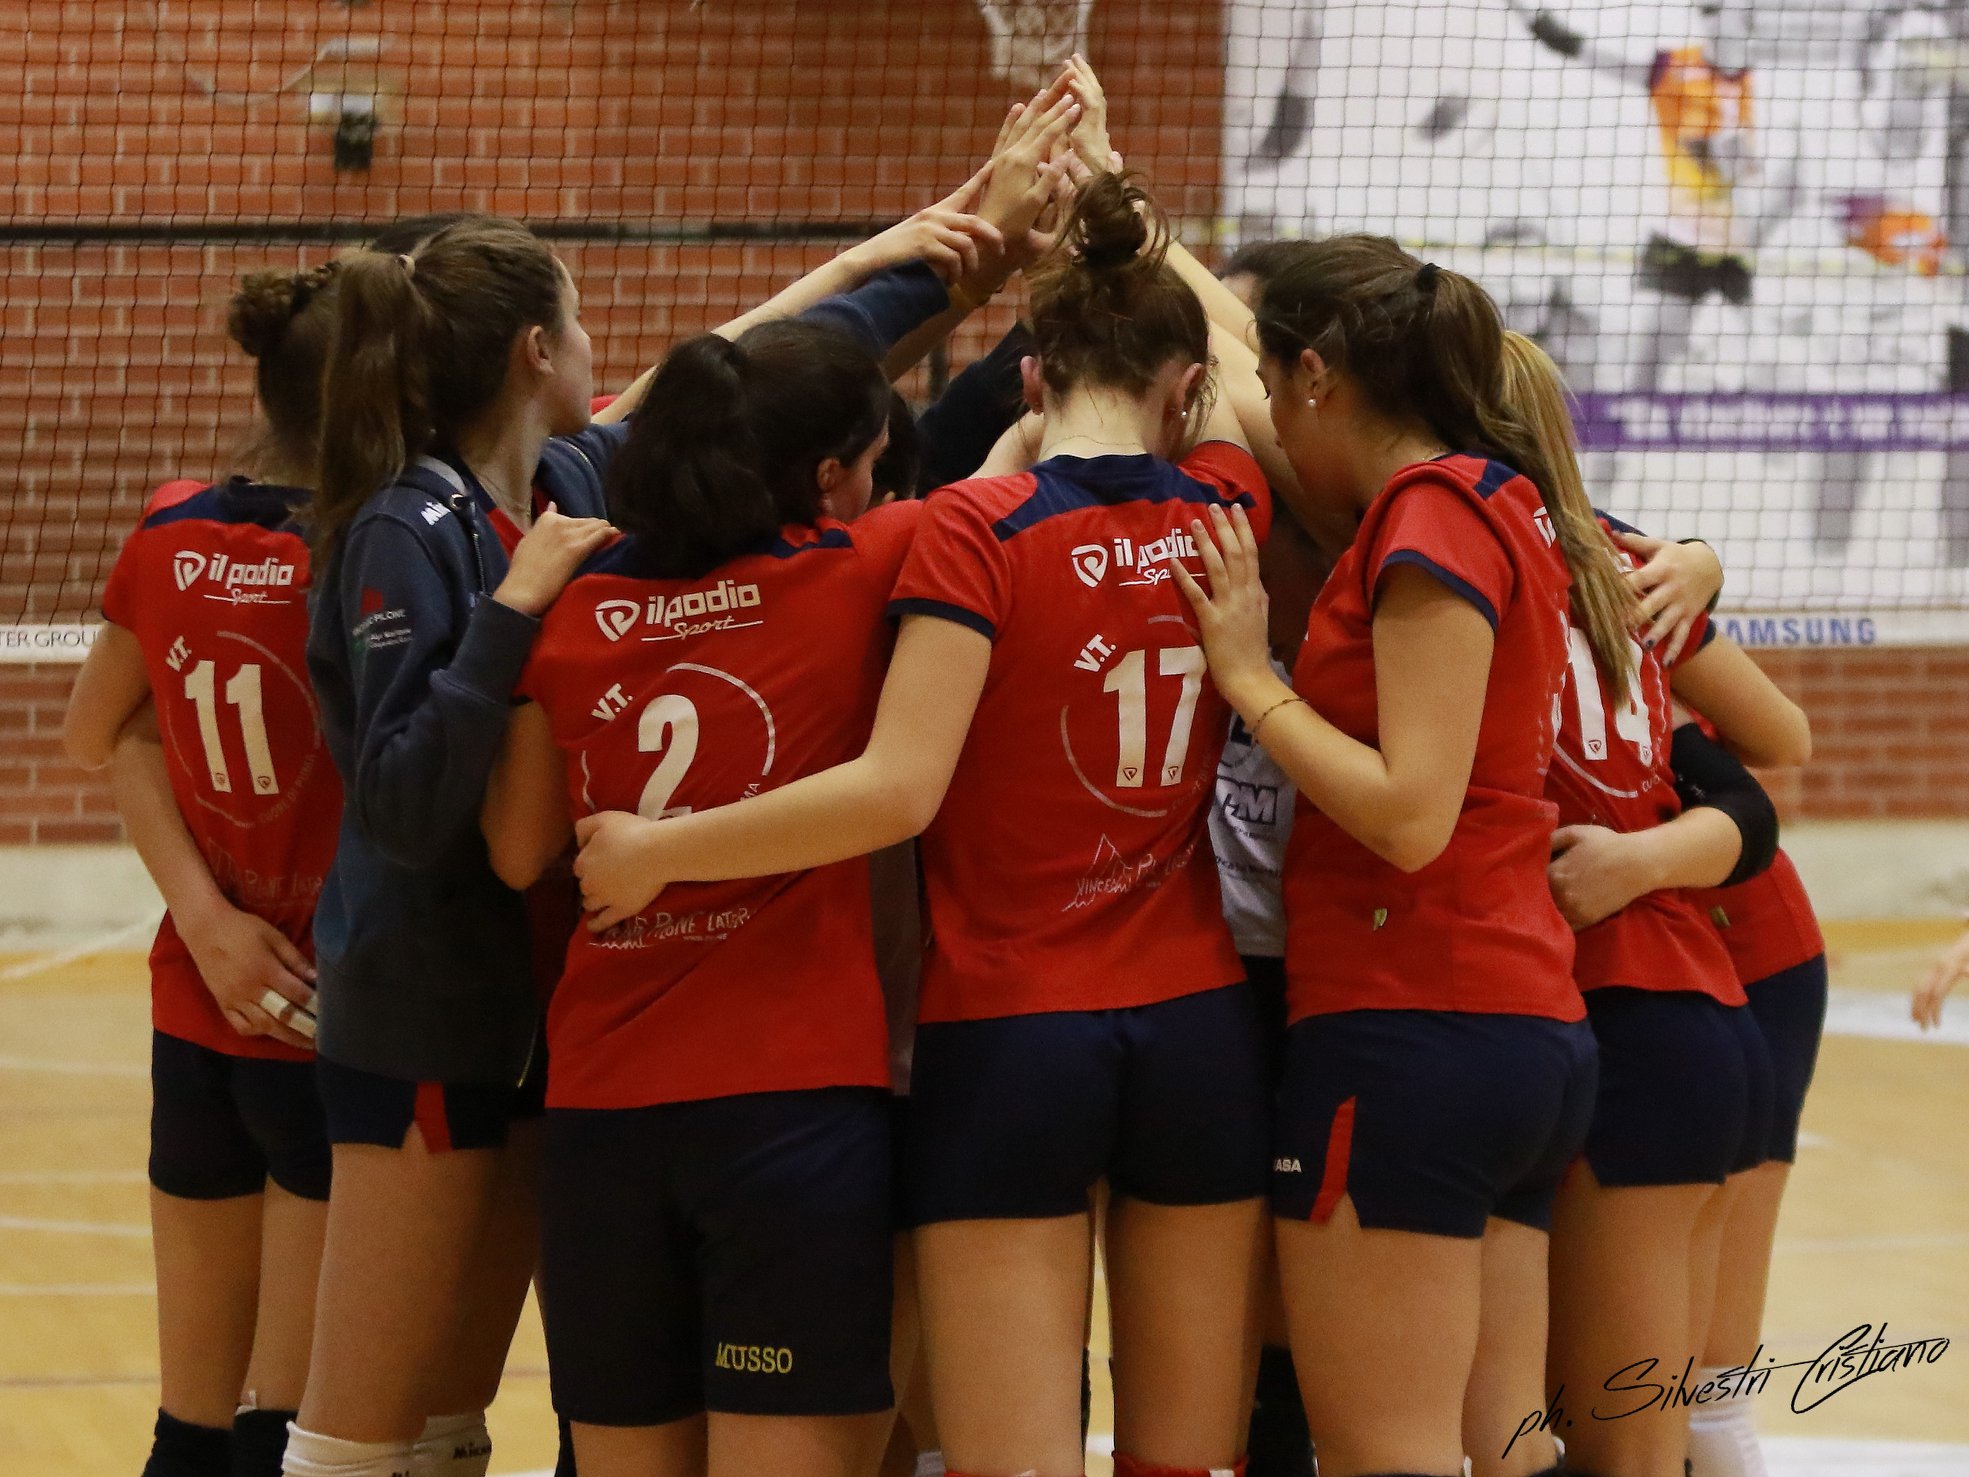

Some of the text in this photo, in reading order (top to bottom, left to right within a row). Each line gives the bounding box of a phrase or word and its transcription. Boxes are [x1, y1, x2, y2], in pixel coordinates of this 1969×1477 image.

[673, 615, 735, 640] Sport
[1073, 634, 1117, 673] V.T.
[184, 659, 279, 796] 11
[591, 683, 634, 722] V.T.
[1103, 645, 1207, 788] 17
[638, 694, 700, 823] 2
